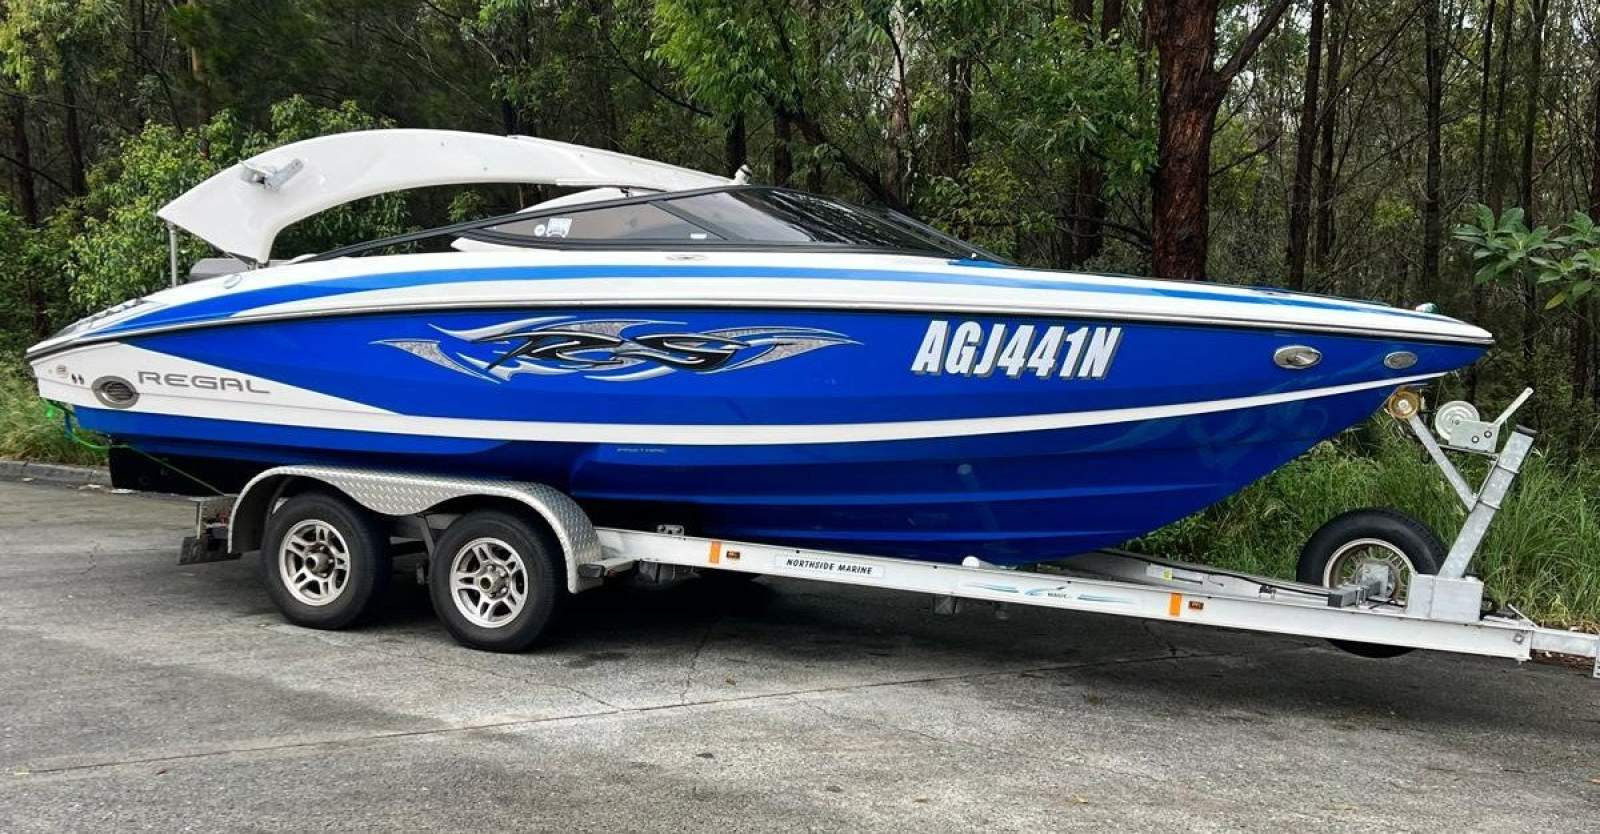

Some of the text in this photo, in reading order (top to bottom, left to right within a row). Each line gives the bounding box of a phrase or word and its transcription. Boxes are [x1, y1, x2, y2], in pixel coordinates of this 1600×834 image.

[911, 320, 1122, 379] AGJ441N
[137, 370, 271, 394] REGAL
[786, 559, 873, 575] NORTHSIDE MARINE
